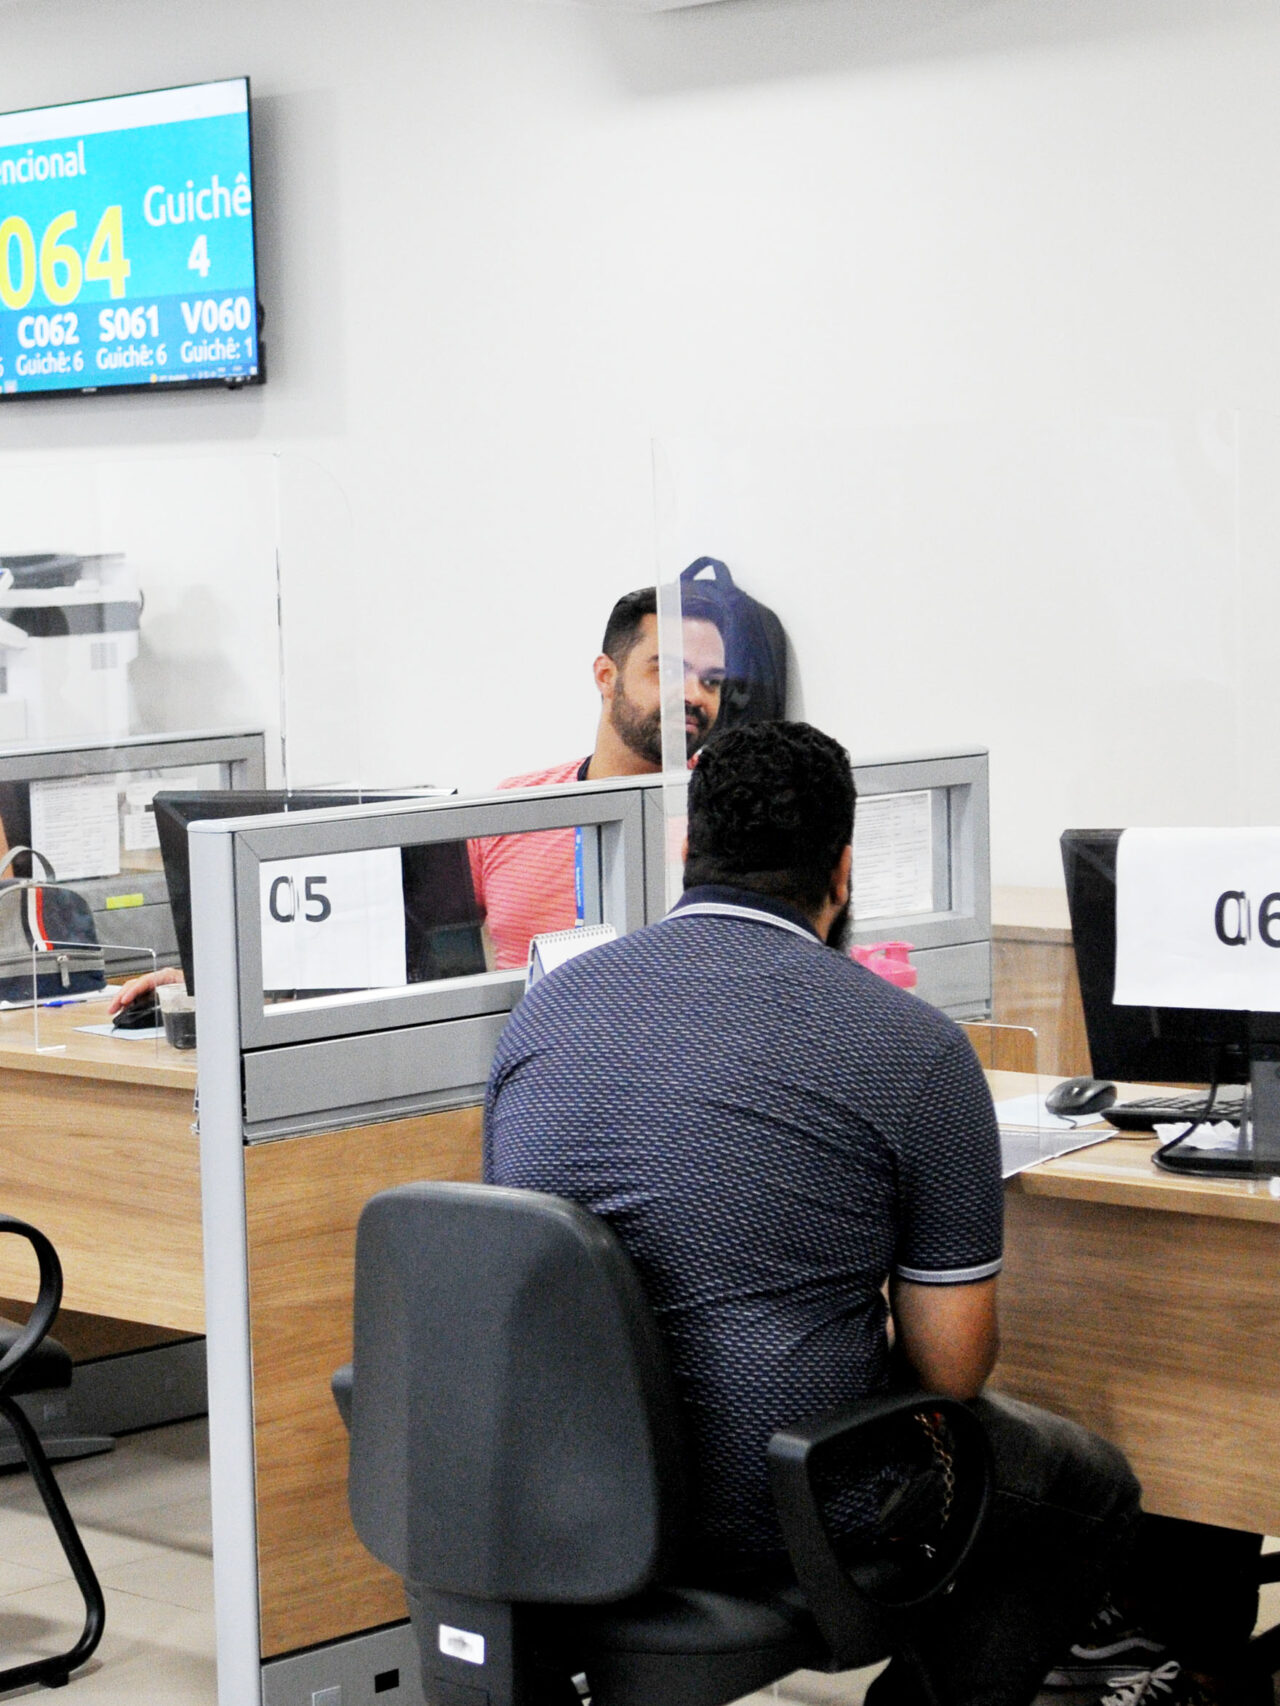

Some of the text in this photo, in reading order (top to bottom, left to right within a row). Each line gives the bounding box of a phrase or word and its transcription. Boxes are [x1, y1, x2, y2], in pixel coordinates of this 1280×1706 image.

[143, 171, 252, 227] Guichê
[187, 234, 212, 278] 4
[17, 311, 80, 349] C062
[98, 304, 160, 342] S061
[180, 296, 252, 334] V060
[16, 350, 84, 376] Guichê: 6
[96, 343, 168, 370] Guichê: 6
[180, 336, 253, 363] Guichê: 1
[269, 875, 332, 923] 05
[1214, 890, 1280, 949] 06
